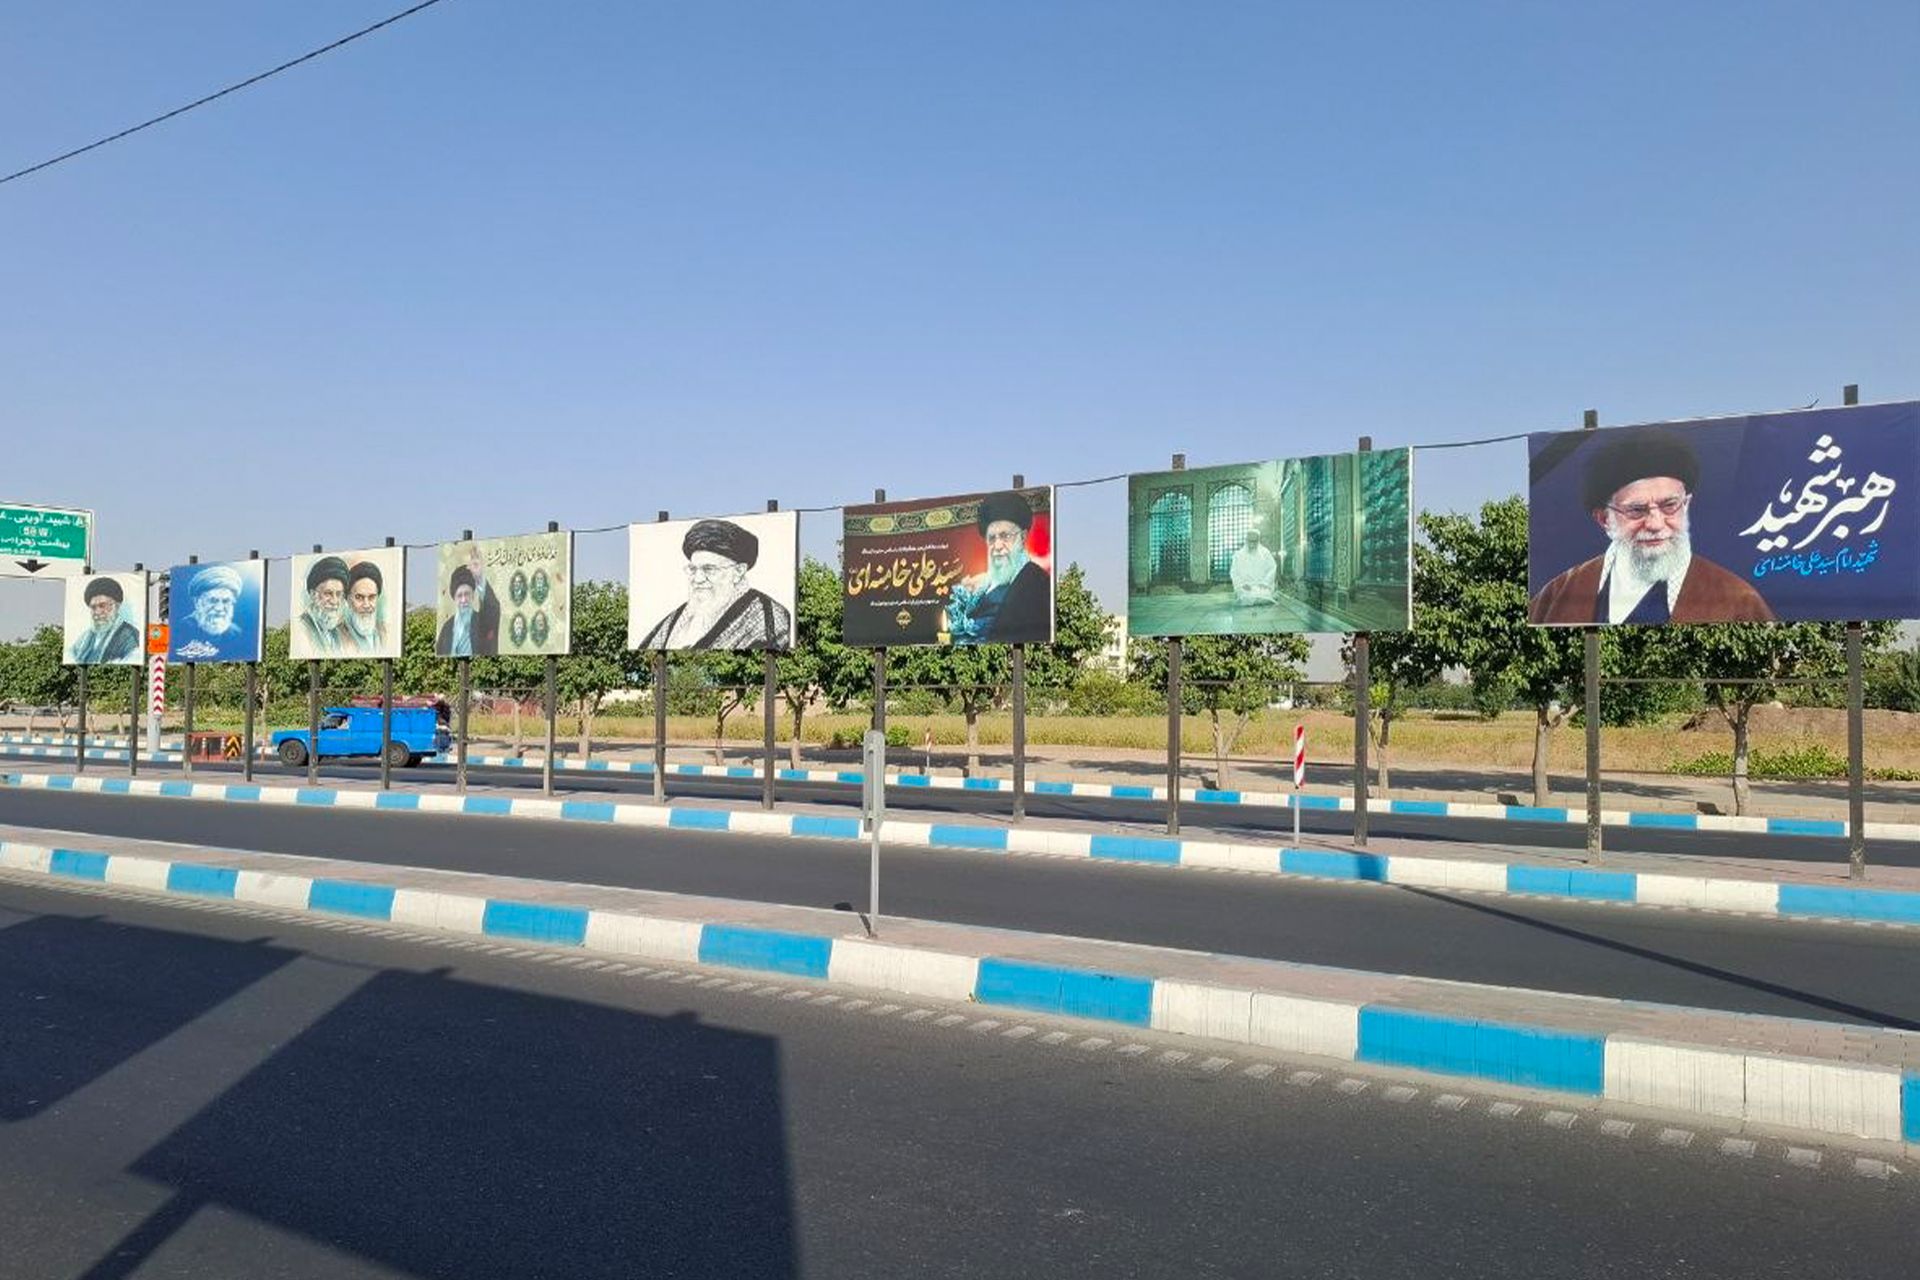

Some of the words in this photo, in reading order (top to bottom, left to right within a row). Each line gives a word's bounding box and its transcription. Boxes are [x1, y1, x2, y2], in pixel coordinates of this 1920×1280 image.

[1738, 433, 1843, 553] شهید
[1792, 470, 1897, 550] رهبر
[908, 551, 937, 597] علی
[1835, 546, 1852, 574] امام
